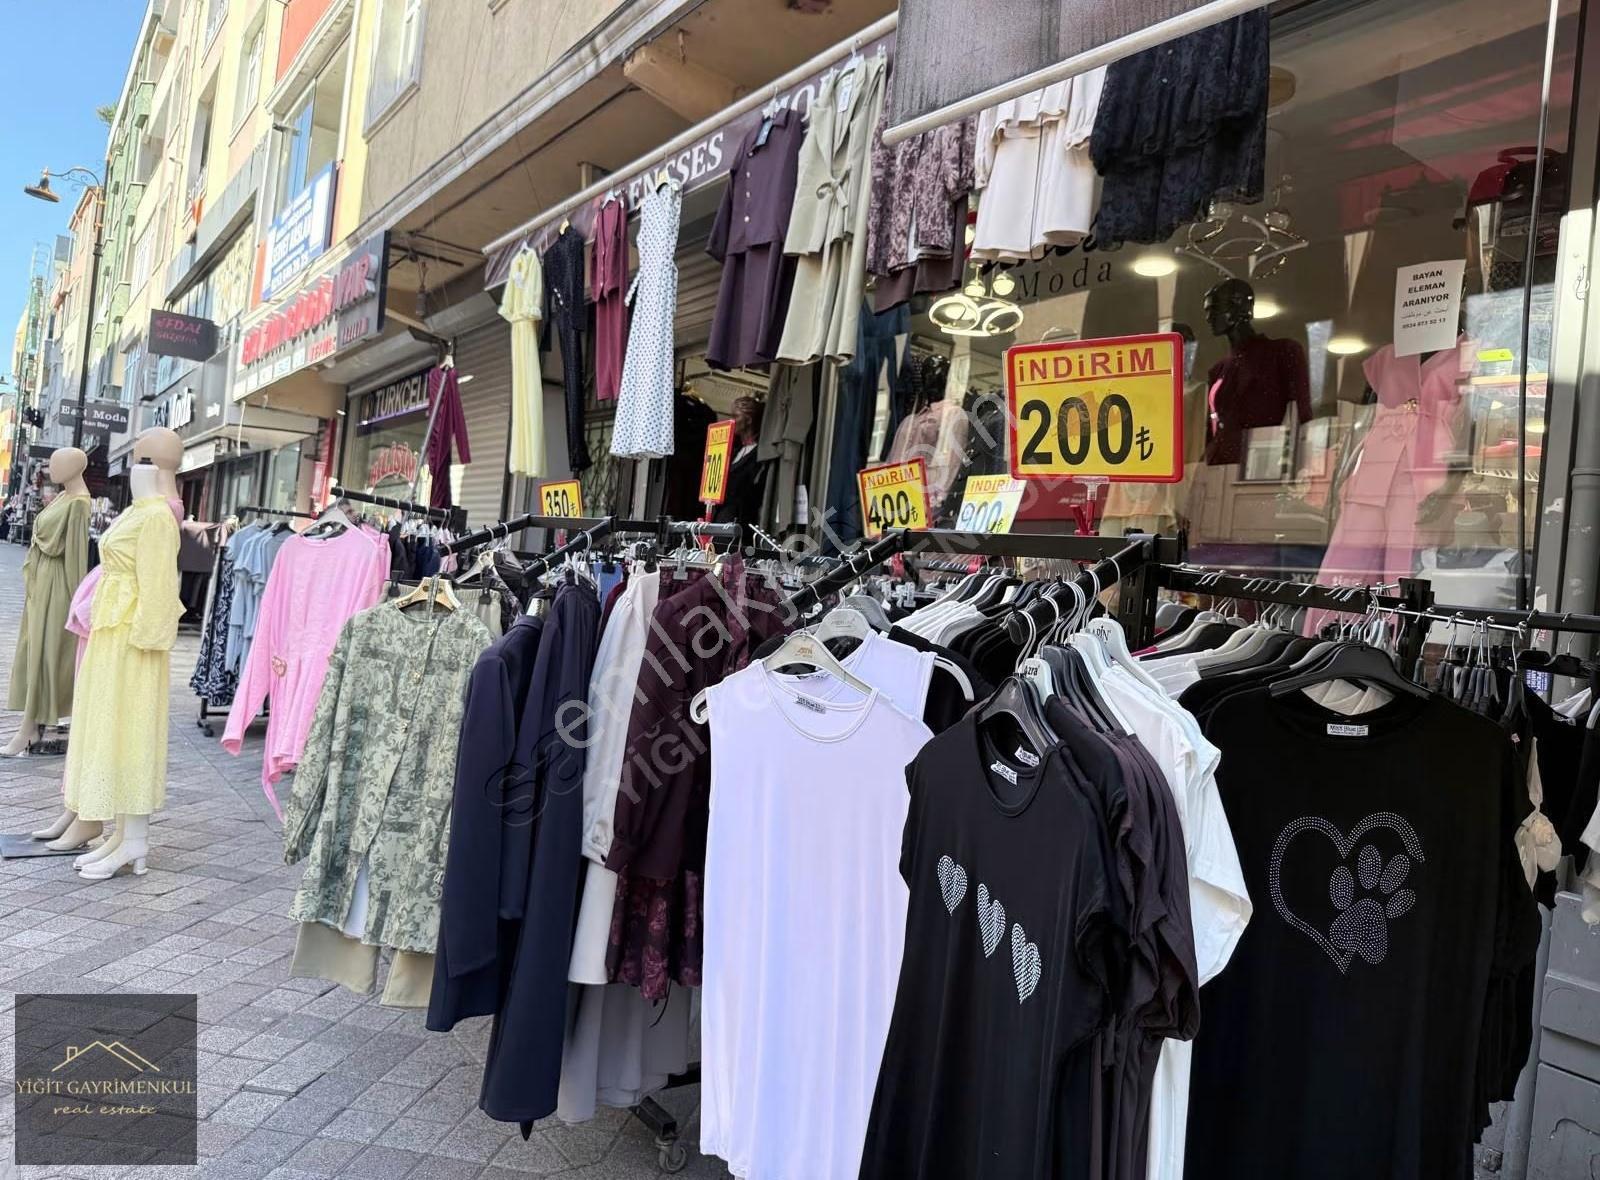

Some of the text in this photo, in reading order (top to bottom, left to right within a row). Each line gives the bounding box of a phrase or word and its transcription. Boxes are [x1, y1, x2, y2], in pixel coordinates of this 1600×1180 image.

[1018, 257, 1112, 299] Moda
[1412, 269, 1443, 281] BAYAN
[1407, 281, 1445, 294] ELEMAN
[1402, 293, 1449, 308] ARANIYOR
[92, 410, 127, 423] Moda
